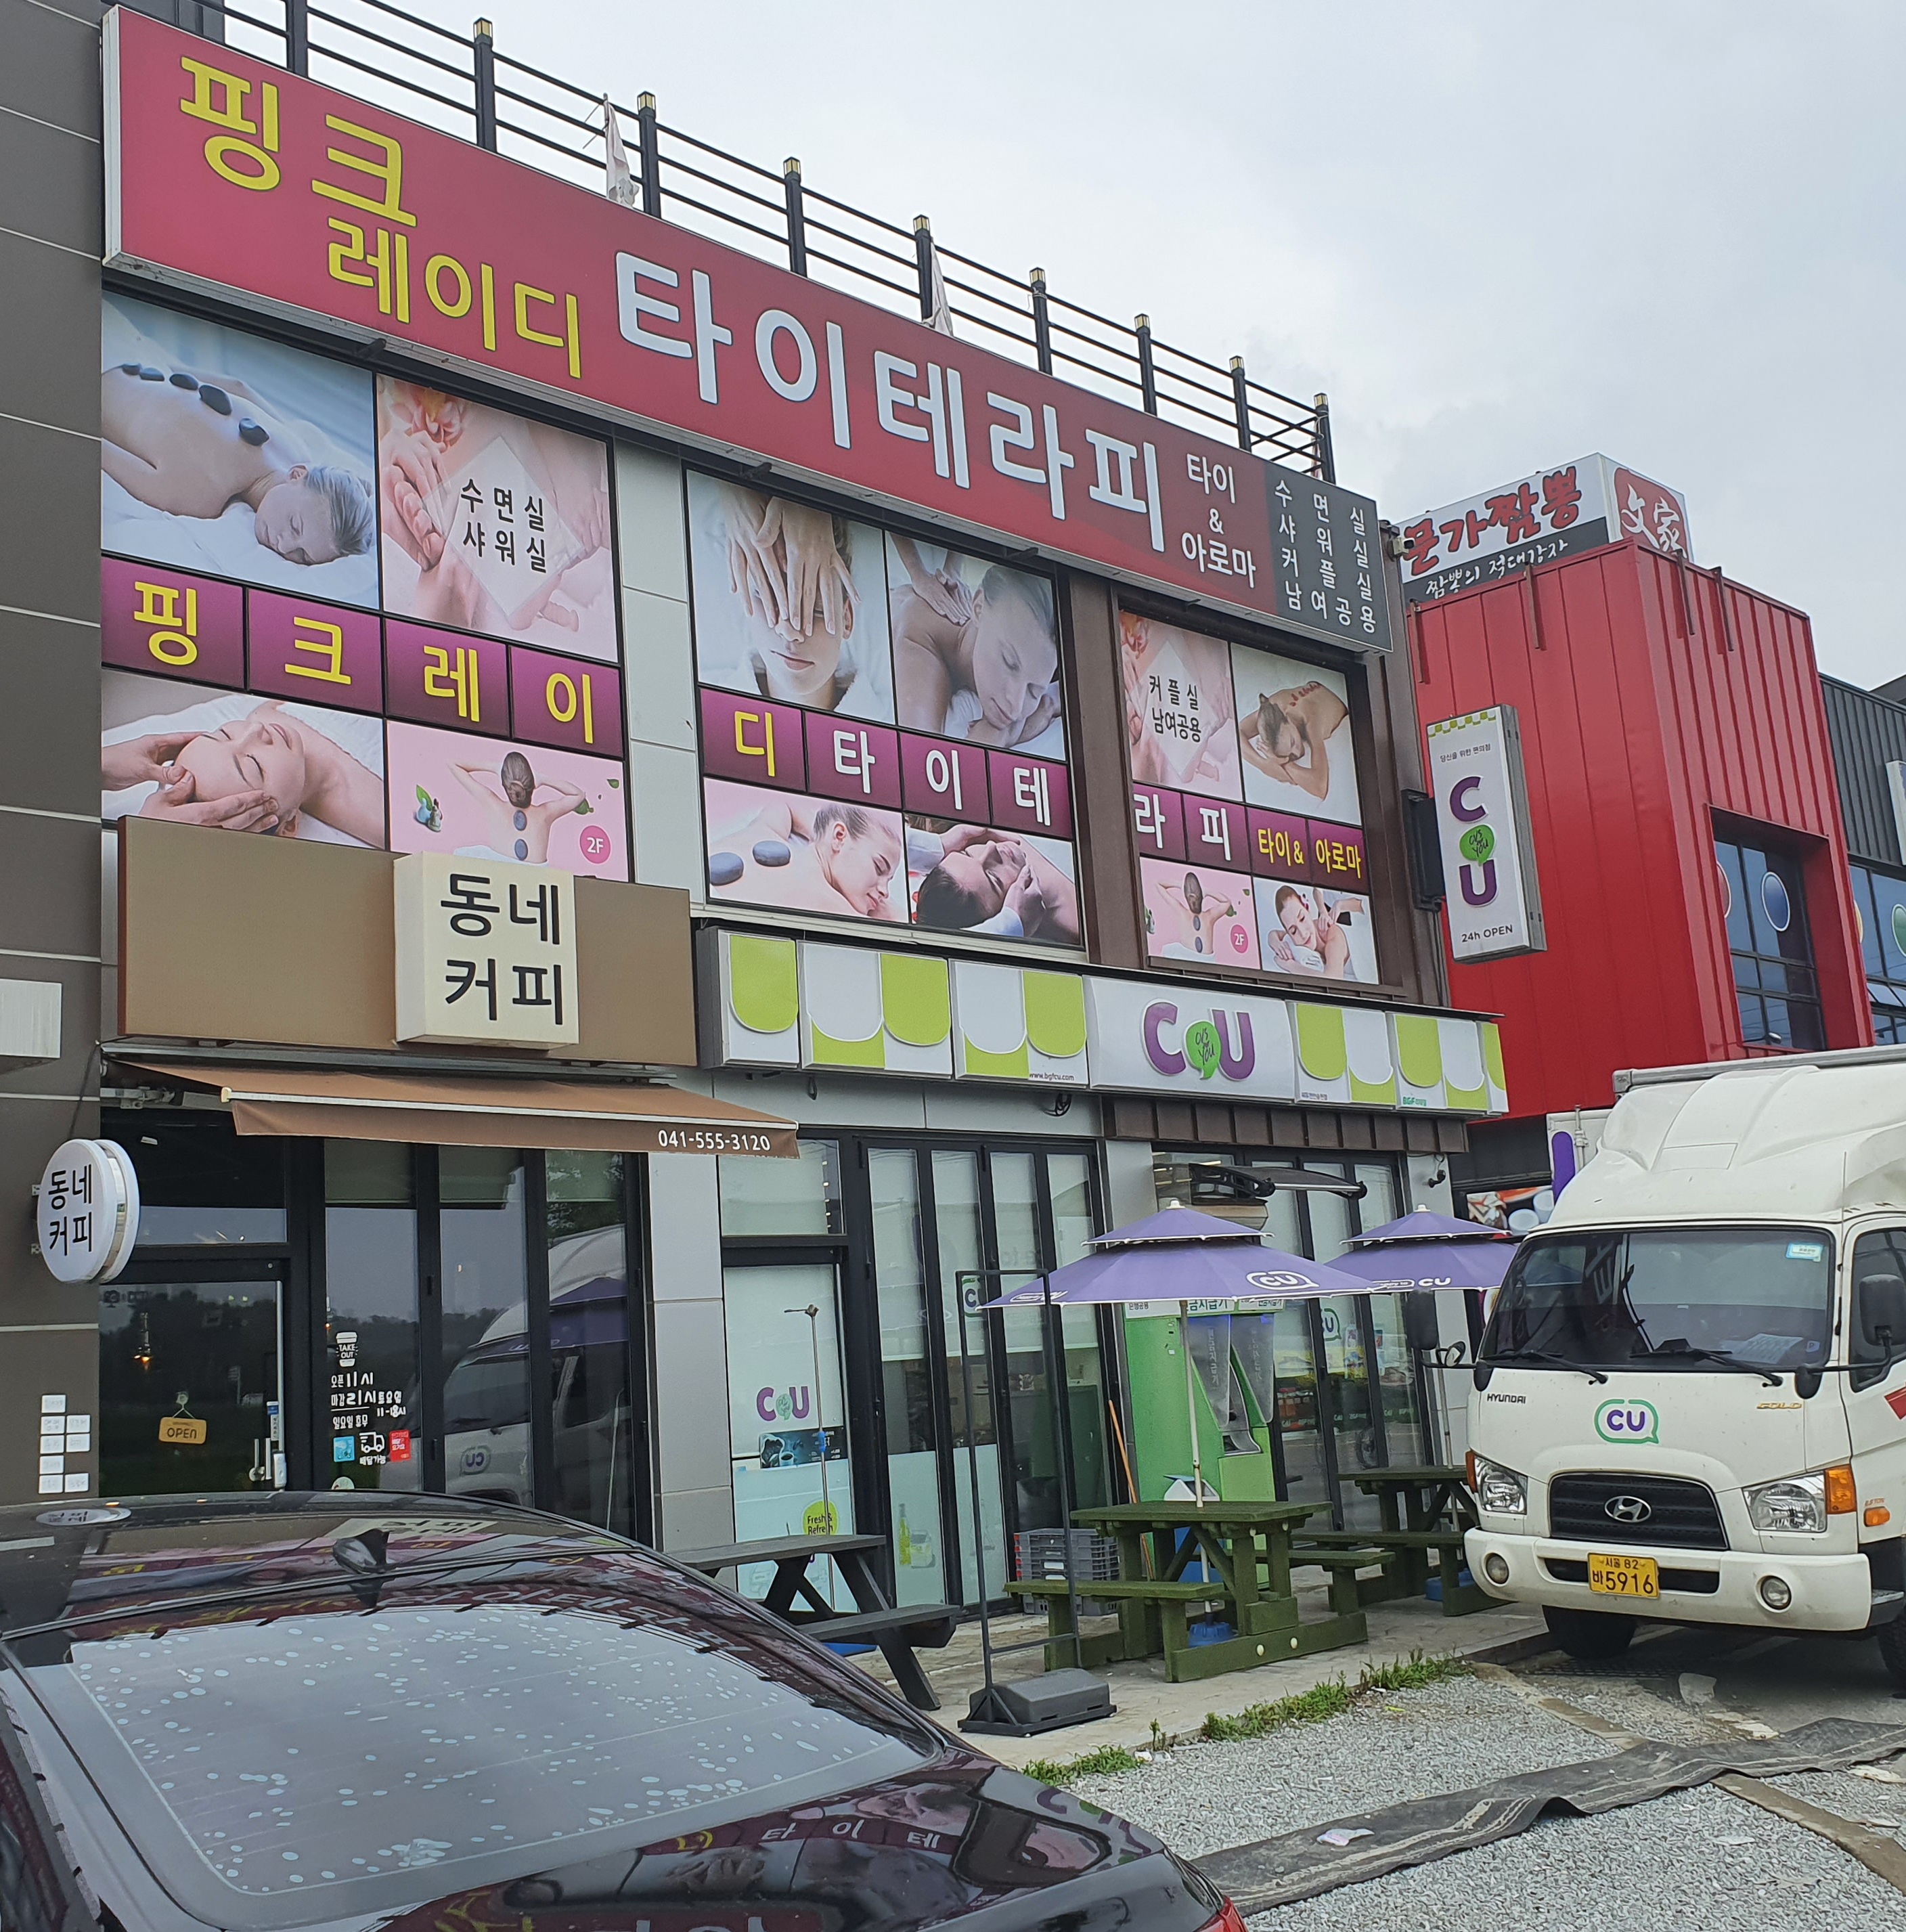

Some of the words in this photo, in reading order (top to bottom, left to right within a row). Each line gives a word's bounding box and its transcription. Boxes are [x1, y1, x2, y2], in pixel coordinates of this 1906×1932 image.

[180, 56, 417, 227] 핑크
[328, 217, 581, 379] 레이디
[615, 251, 1165, 552] 타이테라피
[1187, 453, 1236, 504] 타이
[460, 478, 545, 528] 수면실
[1275, 479, 1366, 537] 수면실
[1209, 508, 1224, 535] &
[462, 520, 547, 574] 샤워실
[1279, 514, 1369, 569] 샤워실
[1181, 532, 1256, 589] 아로마
[1281, 546, 1373, 602] 커플실
[1285, 580, 1377, 634] 남여공용
[1149, 675, 1199, 711] 커플실
[1152, 707, 1201, 743] 남여공용
[586, 837, 604, 854] 2F
[1316, 839, 1362, 879] 아로마
[441, 873, 560, 945] 동네
[1235, 933, 1245, 946] 2F
[1461, 931, 1480, 943] 24h
[1483, 924, 1513, 939] OPEN
[445, 958, 563, 1026] 커피
[658, 1130, 770, 1151] 041-555-3120
[48, 1164, 93, 1210] 동네
[49, 1212, 93, 1256] 커피
[1260, 1274, 1298, 1286] CU
[1418, 1277, 1451, 1286] CU
[331, 1374, 344, 1388] 오픈
[1487, 1393, 1526, 1404] HYUNDAI
[331, 1394, 345, 1407] 마감
[755, 1386, 810, 1421] CU
[167, 1427, 197, 1439] OPEN
[332, 1415, 353, 1430] 일요일
[355, 1414, 368, 1428] 휴무
[1607, 1409, 1645, 1432] CU
[808, 1524, 833, 1535] Refreh
[1624, 1558, 1639, 1570] 82
